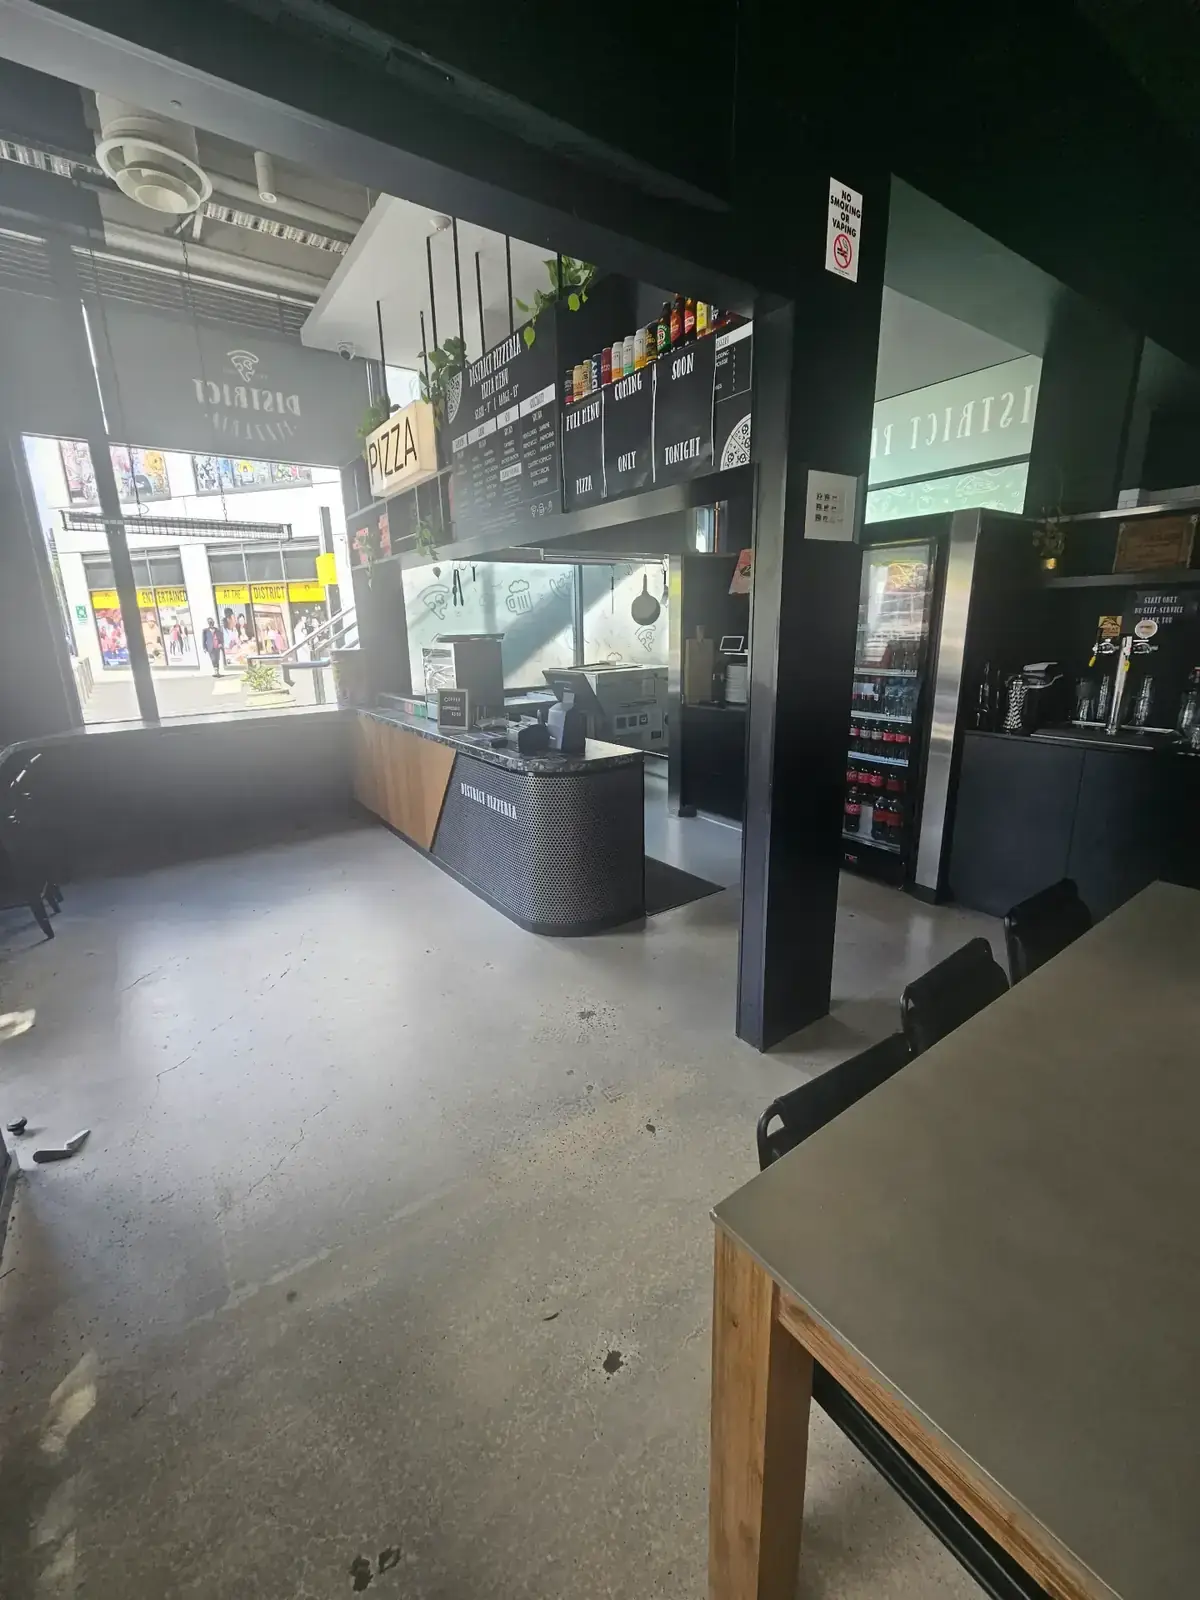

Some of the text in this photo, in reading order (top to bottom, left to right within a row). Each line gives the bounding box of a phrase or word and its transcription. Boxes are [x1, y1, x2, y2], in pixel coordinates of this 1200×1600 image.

[830, 195, 861, 219] SMOKING
[841, 190, 852, 202] NO
[832, 217, 857, 237] VAPING
[840, 212, 850, 224] OR
[492, 332, 522, 371] PIZZERIA
[566, 410, 581, 431] FULL
[582, 401, 600, 425] MENU
[614, 372, 642, 401] COMING
[671, 352, 694, 380] SOON
[368, 416, 418, 486] PIZZA
[576, 436, 701, 495] PIZZA ONLY TONIGHT
[252, 585, 285, 600] DISTRICT
[460, 782, 518, 820] DISTRICT PIZZERIA
